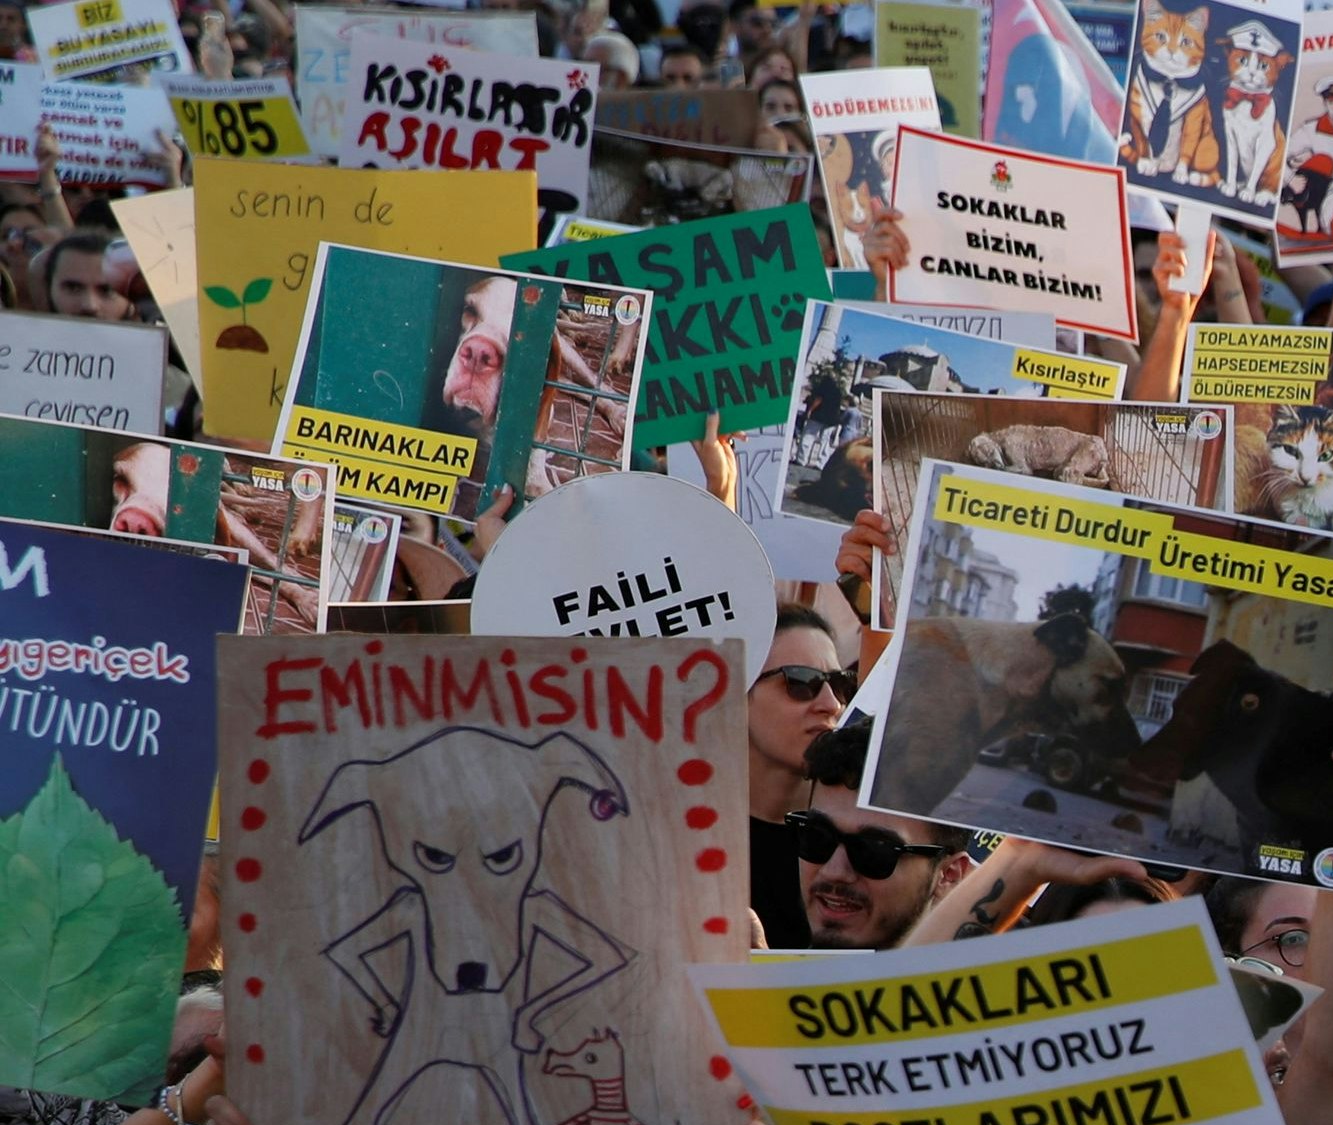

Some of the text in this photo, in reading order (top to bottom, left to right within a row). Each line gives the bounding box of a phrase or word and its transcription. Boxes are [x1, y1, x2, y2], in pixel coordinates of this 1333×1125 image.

[182, 100, 279, 156] %85
[229, 184, 395, 226] senin de
[937, 191, 1067, 231] SOKAKLAR
[966, 229, 1045, 264] BİZİM,
[920, 255, 1103, 302] CANLAR BİZİM!
[583, 302, 611, 319] YASA
[1199, 331, 1329, 351] TOPLAYAMAZSIN
[22, 347, 115, 381] zaman
[1016, 356, 1111, 391] Kısırlaştır
[1197, 356, 1326, 376] HAPSEDEMEZSİN
[1193, 378, 1312, 401] ÖLDÜREMEZSİN
[297, 415, 471, 470] BARINAKLAR
[1156, 422, 1187, 434] YASA
[251, 476, 285, 492] YASA
[365, 470, 449, 506] KAMPI
[944, 486, 1050, 531] Ticareti
[1055, 507, 1152, 550] Durdur
[1158, 534, 1265, 585] Üretimi
[551, 556, 683, 626] FAİLİ
[1259, 856, 1302, 876] YASA
[787, 952, 1113, 1040] SOKAKLARI
[795, 1018, 1155, 1098] TERK ETMİYORUZ
